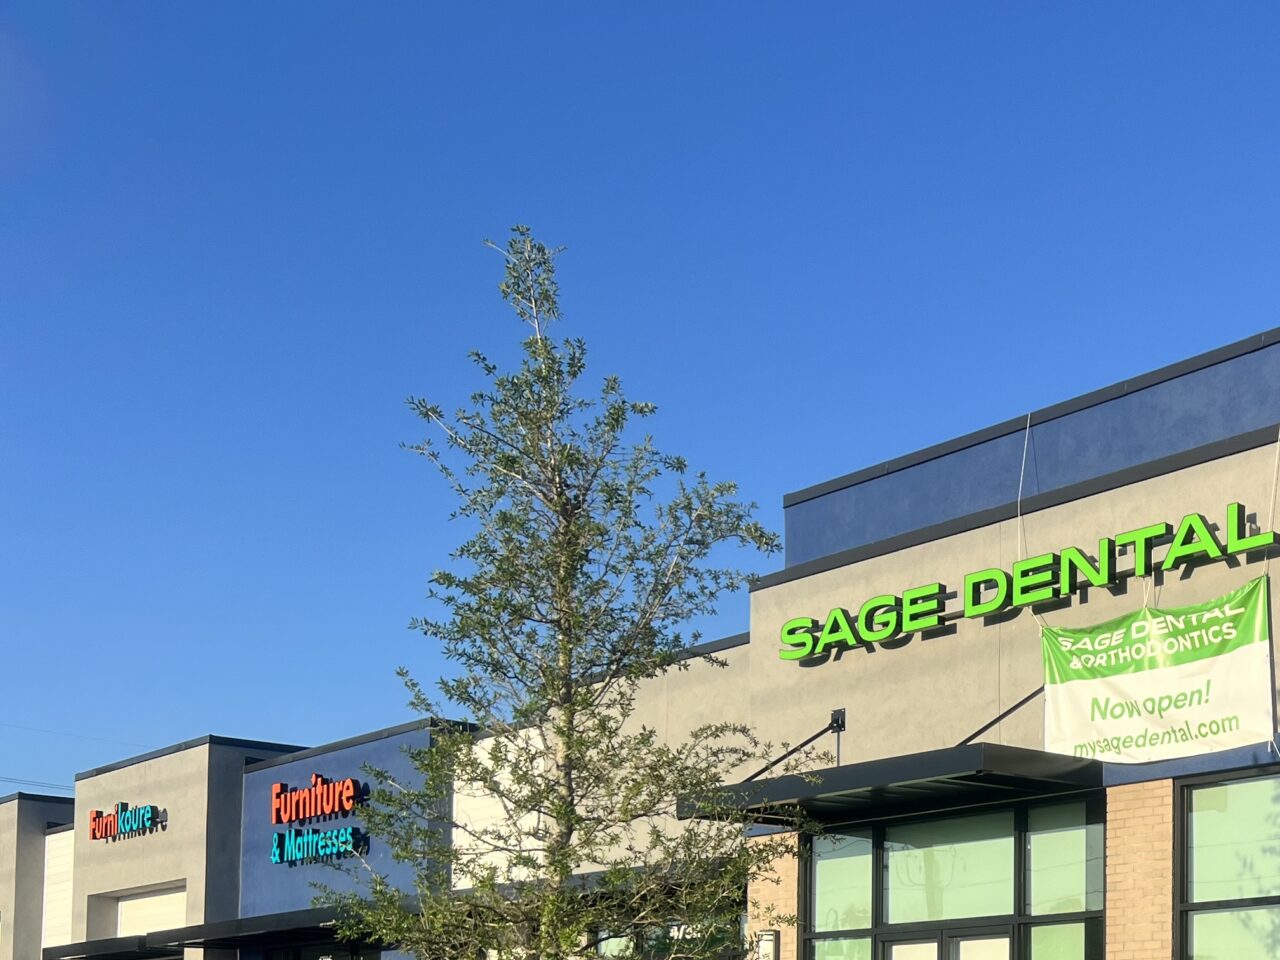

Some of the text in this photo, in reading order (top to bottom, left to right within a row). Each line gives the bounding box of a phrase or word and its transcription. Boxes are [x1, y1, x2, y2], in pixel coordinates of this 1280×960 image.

[779, 502, 1279, 661] SAGE DENTAL
[1057, 603, 1246, 651] SAGE DENTAL
[1081, 621, 1238, 669] ORTHODONTICS
[1090, 679, 1212, 722] Now open!
[1072, 714, 1240, 759] mysagedental.com
[89, 801, 152, 841] Furnikoure
[271, 772, 355, 825] Furniture
[271, 826, 353, 864] & Mattresses
